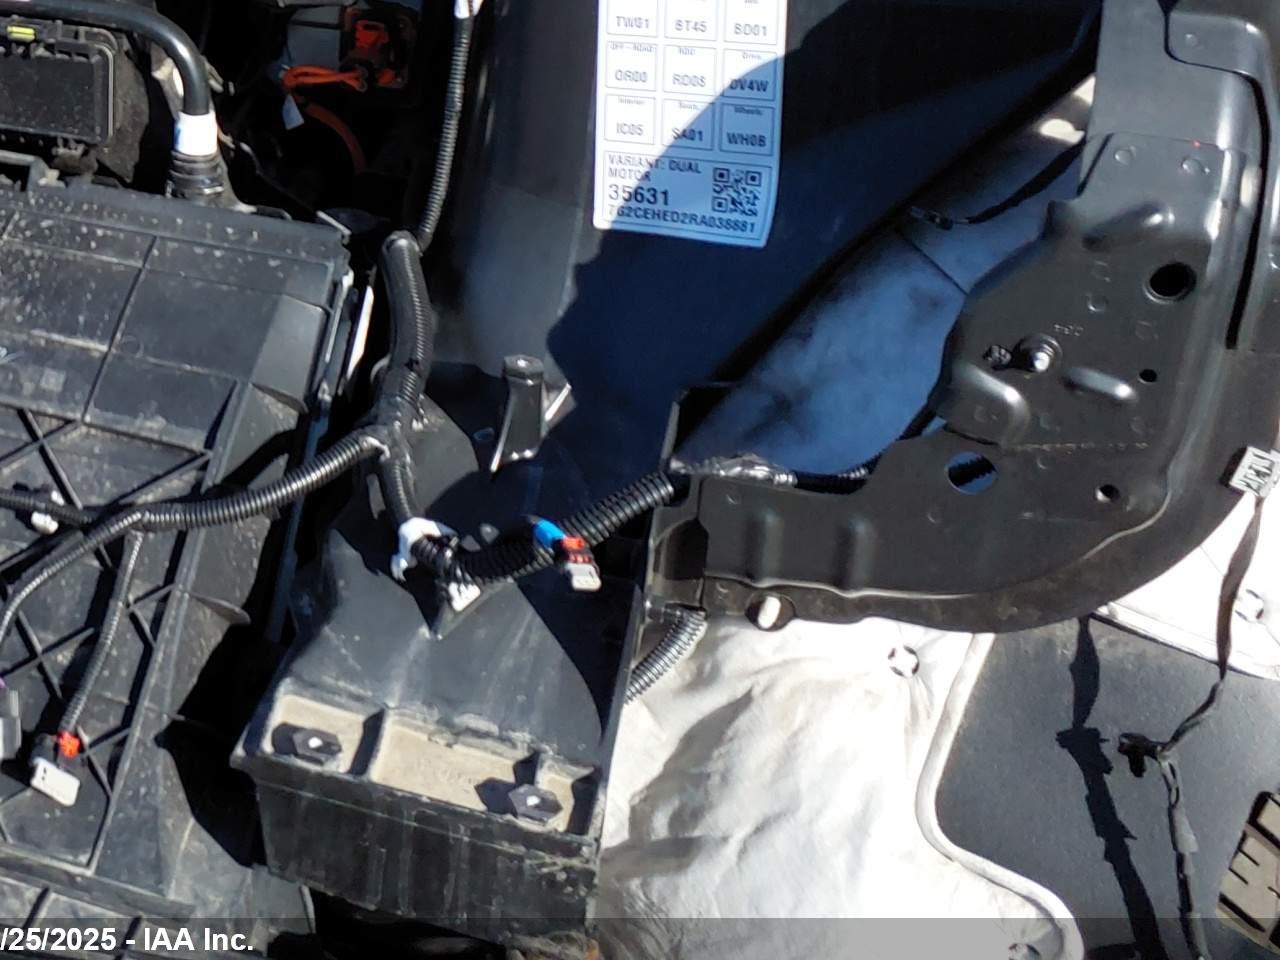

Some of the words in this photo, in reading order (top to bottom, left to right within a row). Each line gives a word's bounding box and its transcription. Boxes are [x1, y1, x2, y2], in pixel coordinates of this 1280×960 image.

[668, 158, 702, 174] DUAL
[608, 167, 651, 182] MOTOR
[608, 183, 670, 206] 35631
